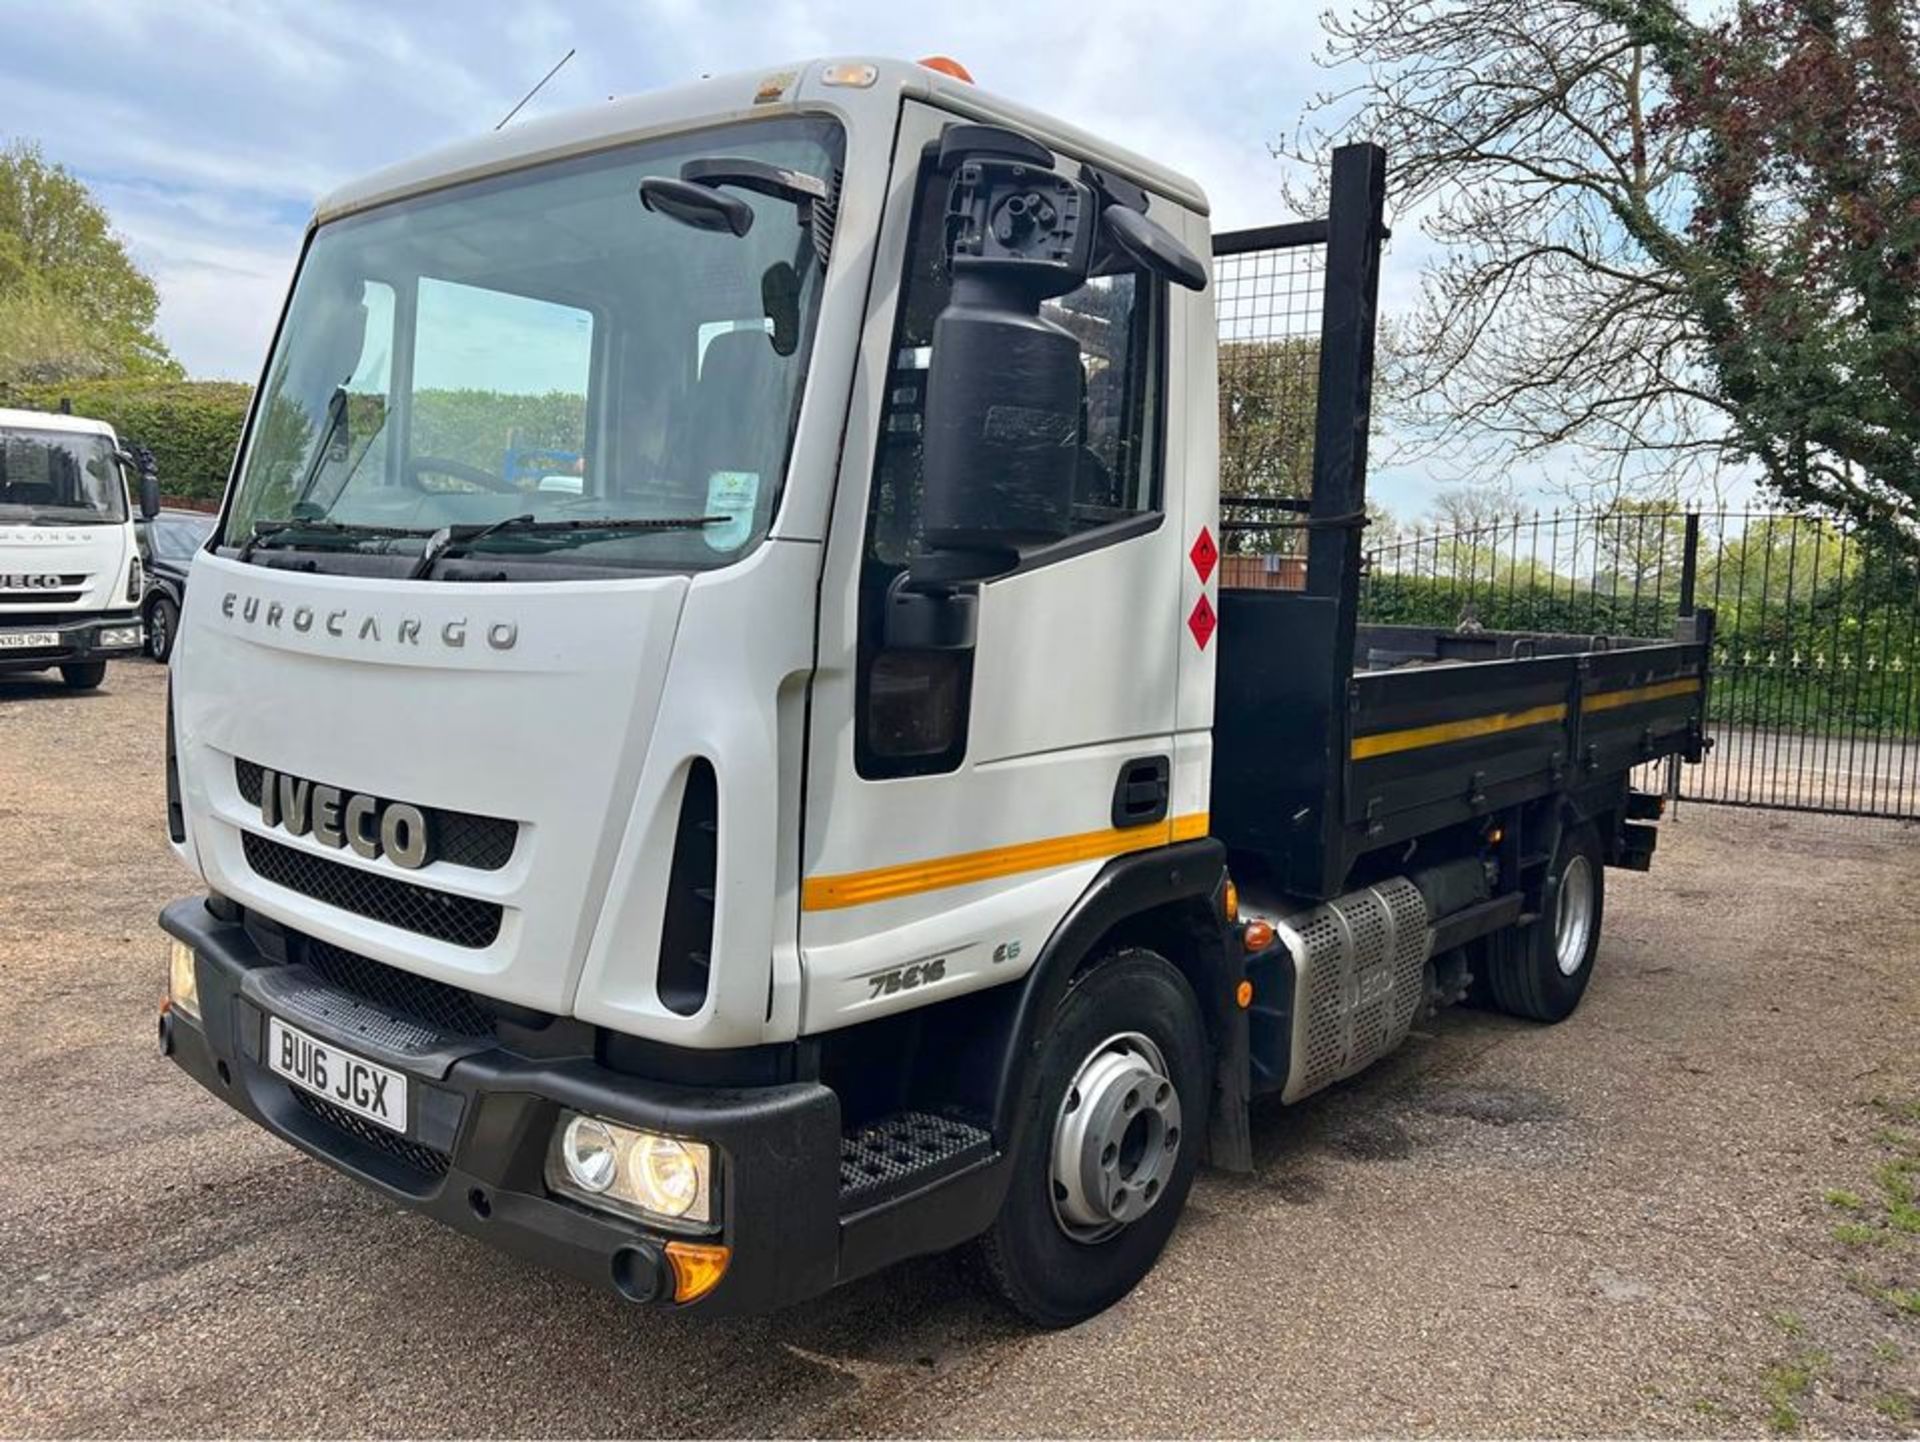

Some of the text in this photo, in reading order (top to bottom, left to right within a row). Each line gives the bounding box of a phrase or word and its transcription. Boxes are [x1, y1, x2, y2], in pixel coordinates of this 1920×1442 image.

[221, 592, 518, 650] EUROCARGO
[261, 769, 428, 869] IVECO
[281, 1029, 387, 1118] BU16 JGX
